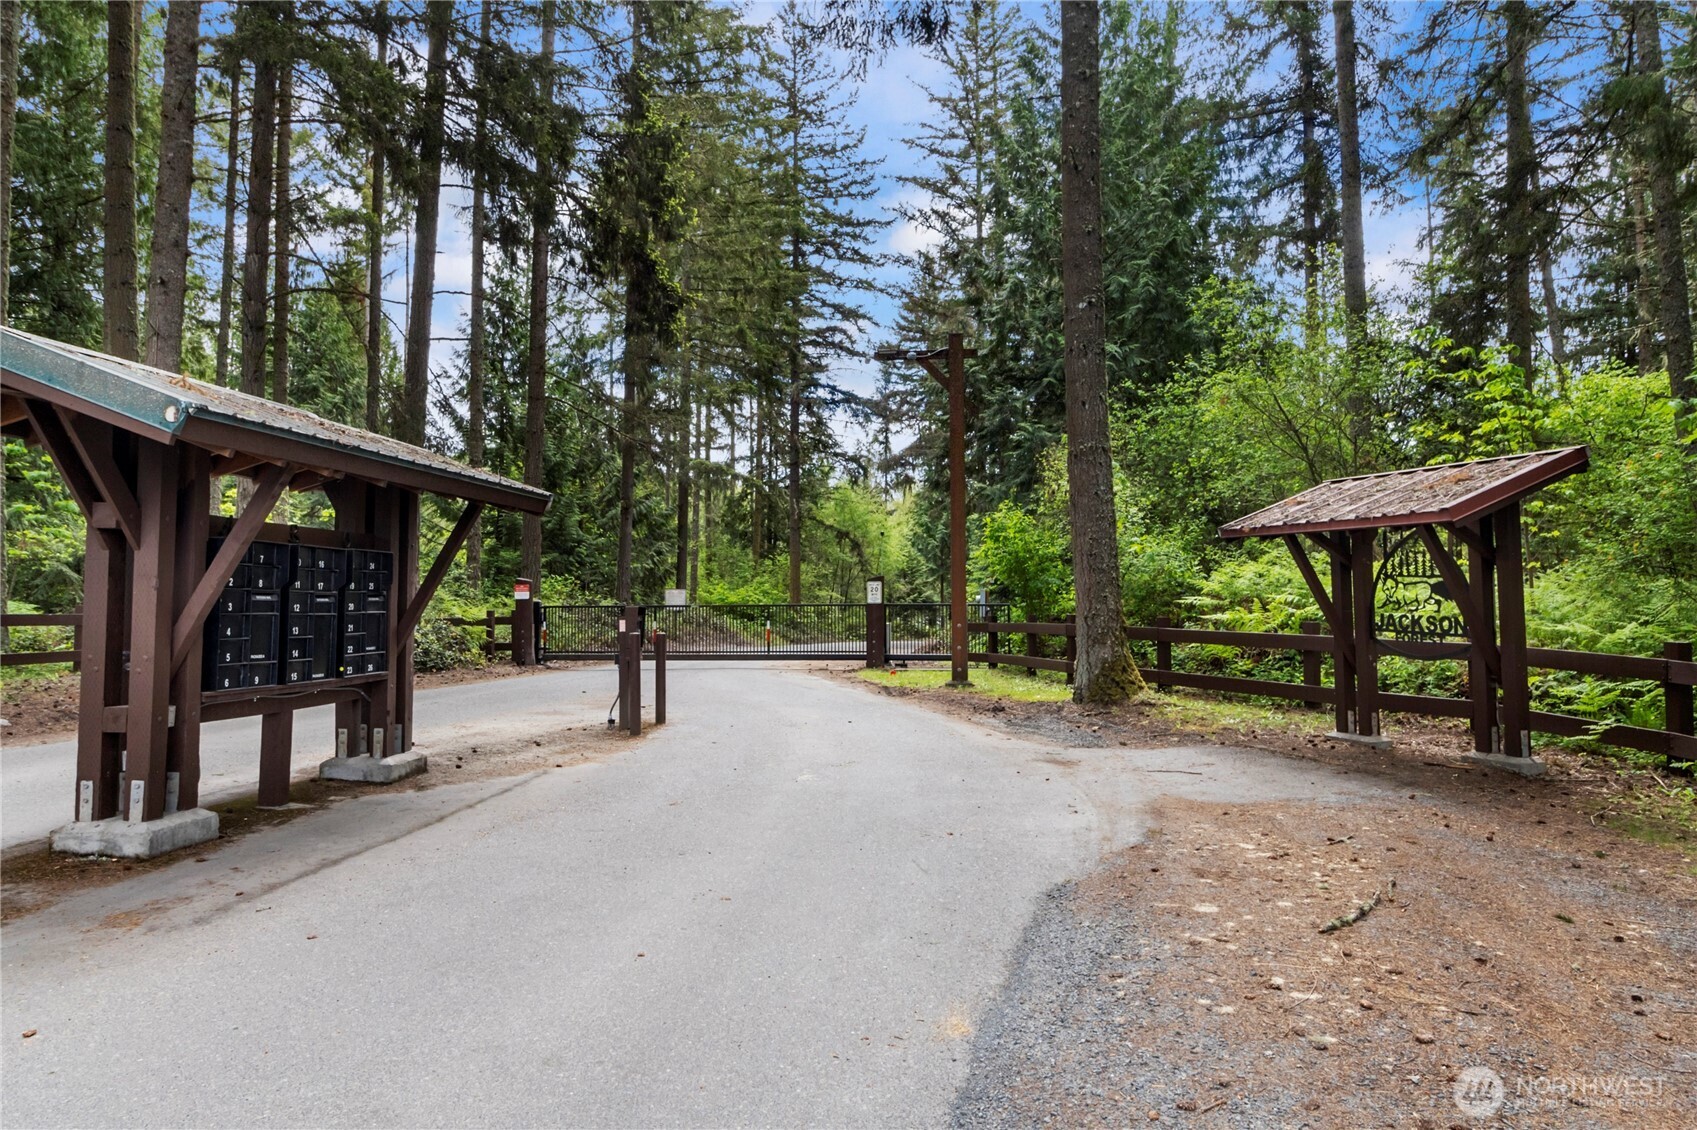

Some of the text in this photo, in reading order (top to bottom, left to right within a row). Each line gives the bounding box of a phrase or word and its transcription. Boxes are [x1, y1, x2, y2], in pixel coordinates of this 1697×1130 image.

[259, 554, 265, 564] 7
[318, 560, 325, 569] 16
[228, 577, 234, 587] 2
[258, 579, 263, 588] 8
[294, 580, 301, 589] 11
[227, 602, 233, 612] 3
[293, 603, 301, 612] 12
[348, 602, 355, 611] 20
[1375, 613, 1468, 636] JACKSON
[226, 627, 232, 636] 4
[292, 626, 299, 635] 13
[292, 649, 299, 658] 14
[347, 645, 354, 654] 22
[225, 652, 231, 662] 5
[346, 666, 353, 675] 23
[254, 675, 259, 685] 9
[290, 672, 298, 681] 15
[224, 678, 230, 688] 6
